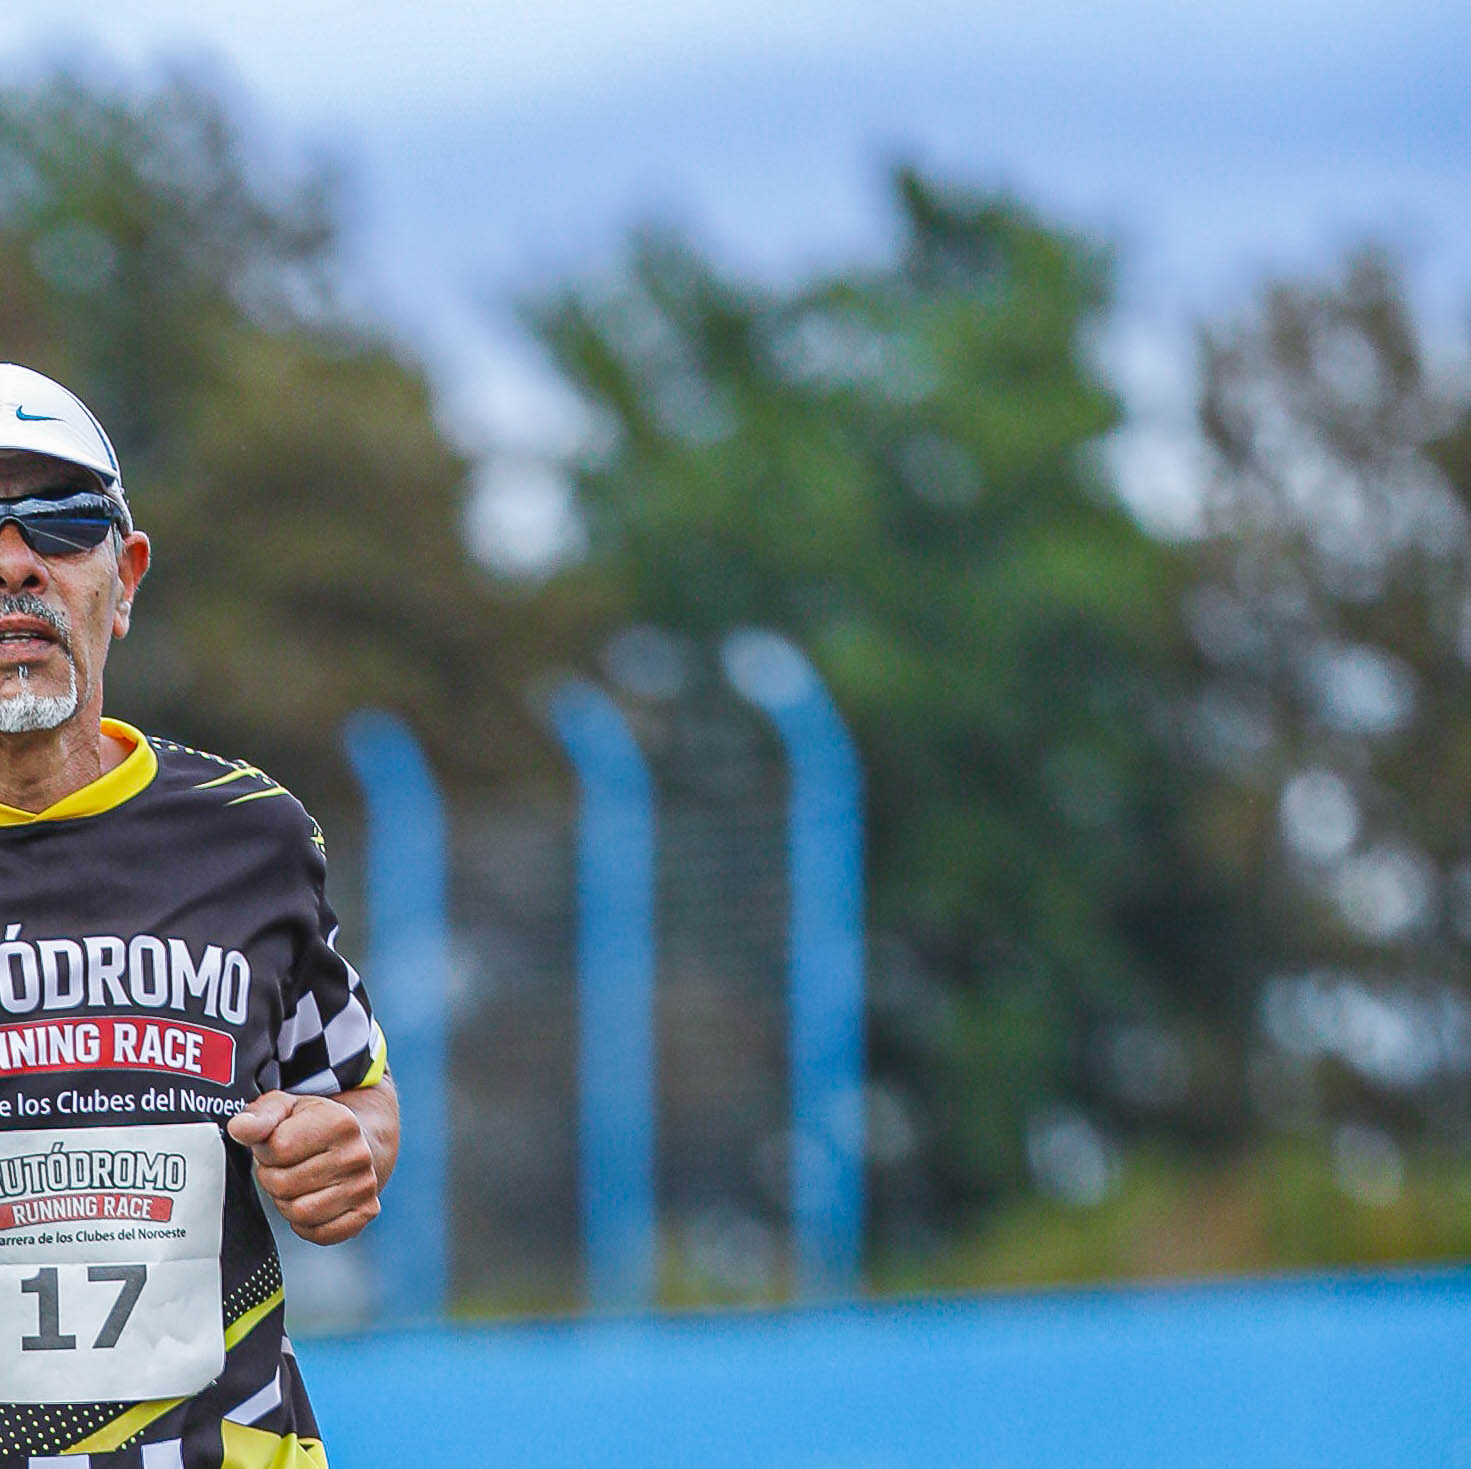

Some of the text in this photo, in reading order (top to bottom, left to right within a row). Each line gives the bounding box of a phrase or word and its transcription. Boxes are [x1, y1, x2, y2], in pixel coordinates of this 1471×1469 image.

[112, 1022, 205, 1073] RACE
[17, 1092, 51, 1117] los
[56, 1088, 136, 1115] Clubes
[140, 1087, 175, 1113] del
[180, 1088, 248, 1117] Noroest
[12, 1194, 153, 1225] RUNNING RACE
[38, 1232, 54, 1245] de
[56, 1231, 73, 1244] los
[75, 1229, 116, 1243] Clubes
[117, 1228, 136, 1241] del
[137, 1227, 187, 1240] Noroeste
[21, 1263, 148, 1353] 17
